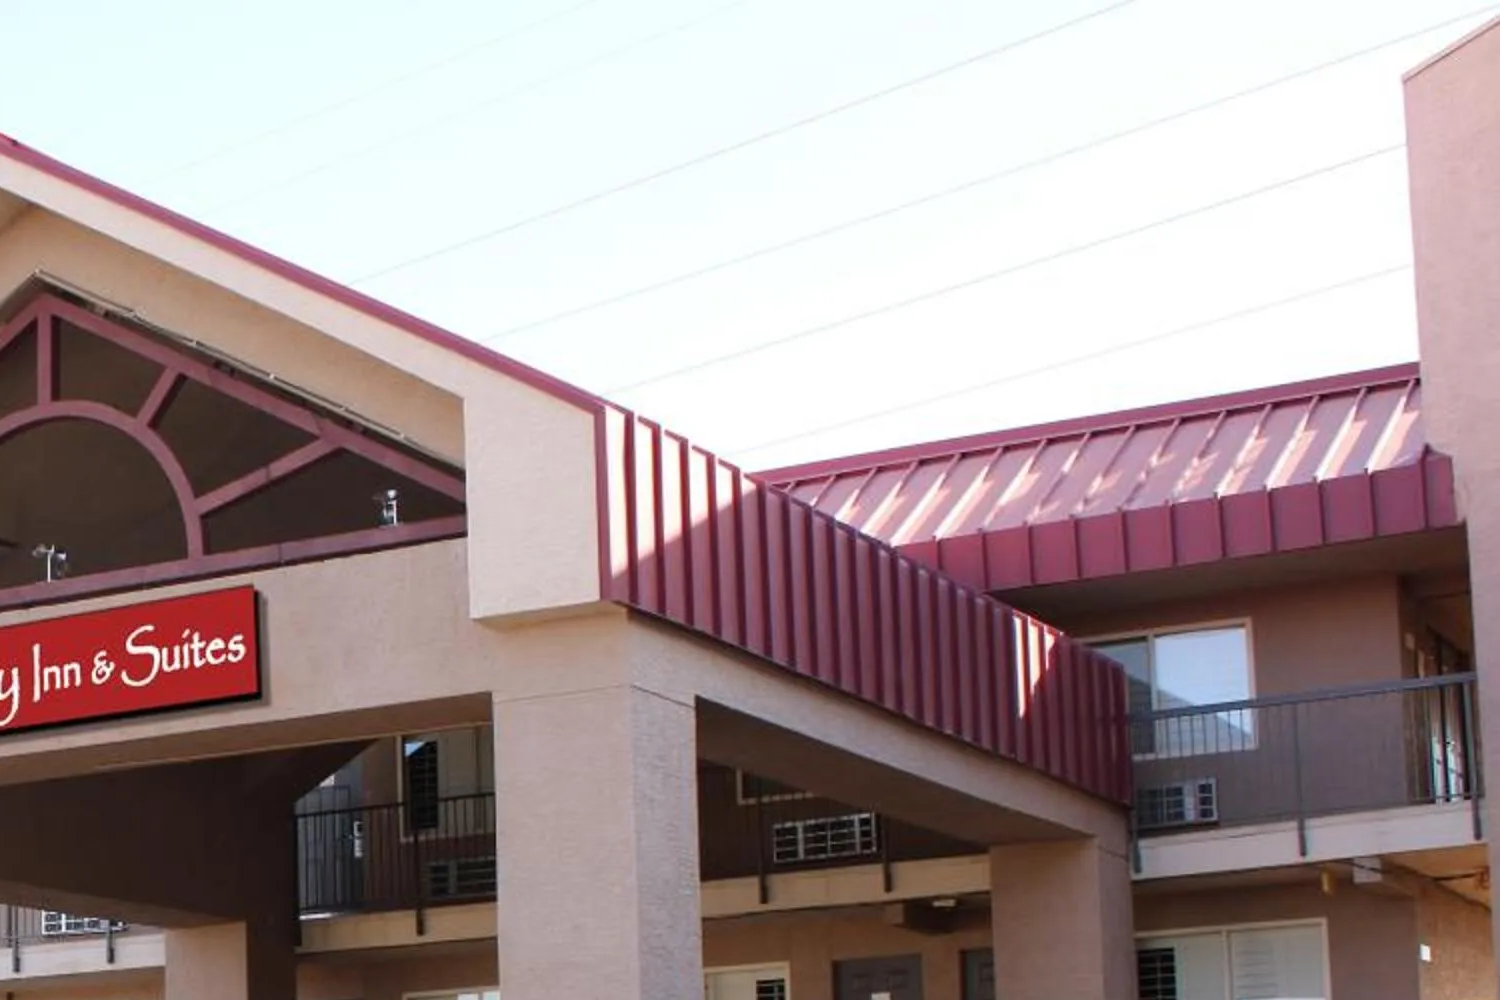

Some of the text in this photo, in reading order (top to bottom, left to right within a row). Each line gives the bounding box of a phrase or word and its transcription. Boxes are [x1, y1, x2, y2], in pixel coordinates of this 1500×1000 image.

[32, 642, 81, 703] Inn
[91, 650, 116, 685] &
[120, 624, 247, 687] Suites
